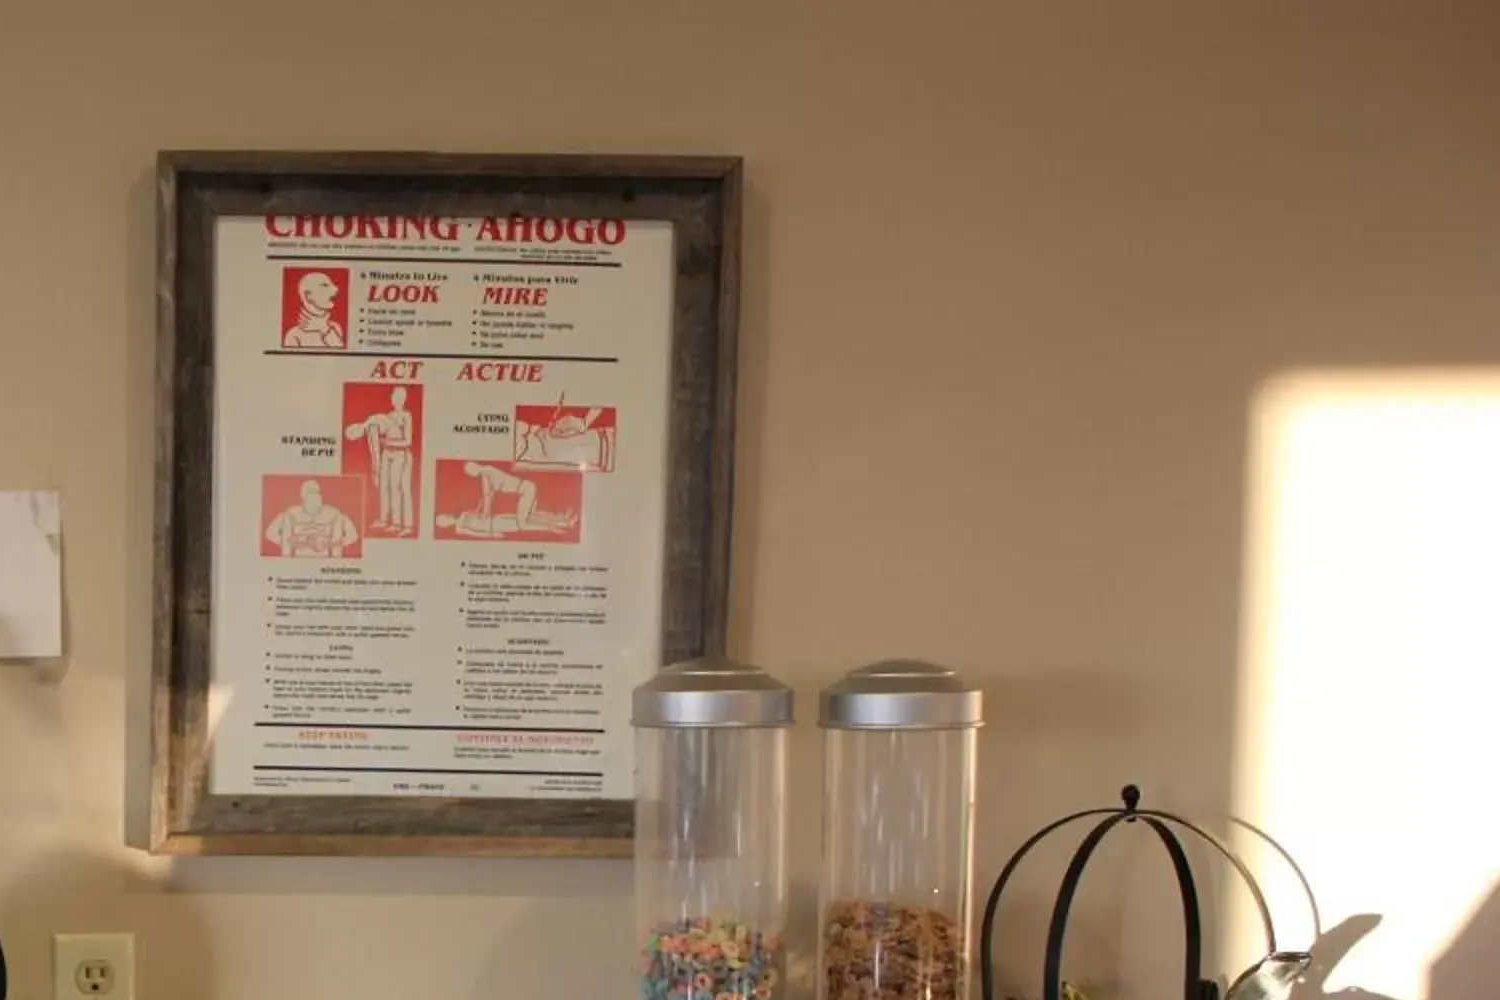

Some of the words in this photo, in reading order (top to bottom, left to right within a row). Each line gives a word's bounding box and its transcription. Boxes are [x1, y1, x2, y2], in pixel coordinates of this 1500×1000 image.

[265, 213, 457, 241] CHOKING
[476, 214, 627, 246] AHOGO
[367, 284, 440, 303] LOOK
[481, 286, 548, 307] MIRE
[370, 360, 424, 380] ACT
[456, 362, 544, 383] ACTUE
